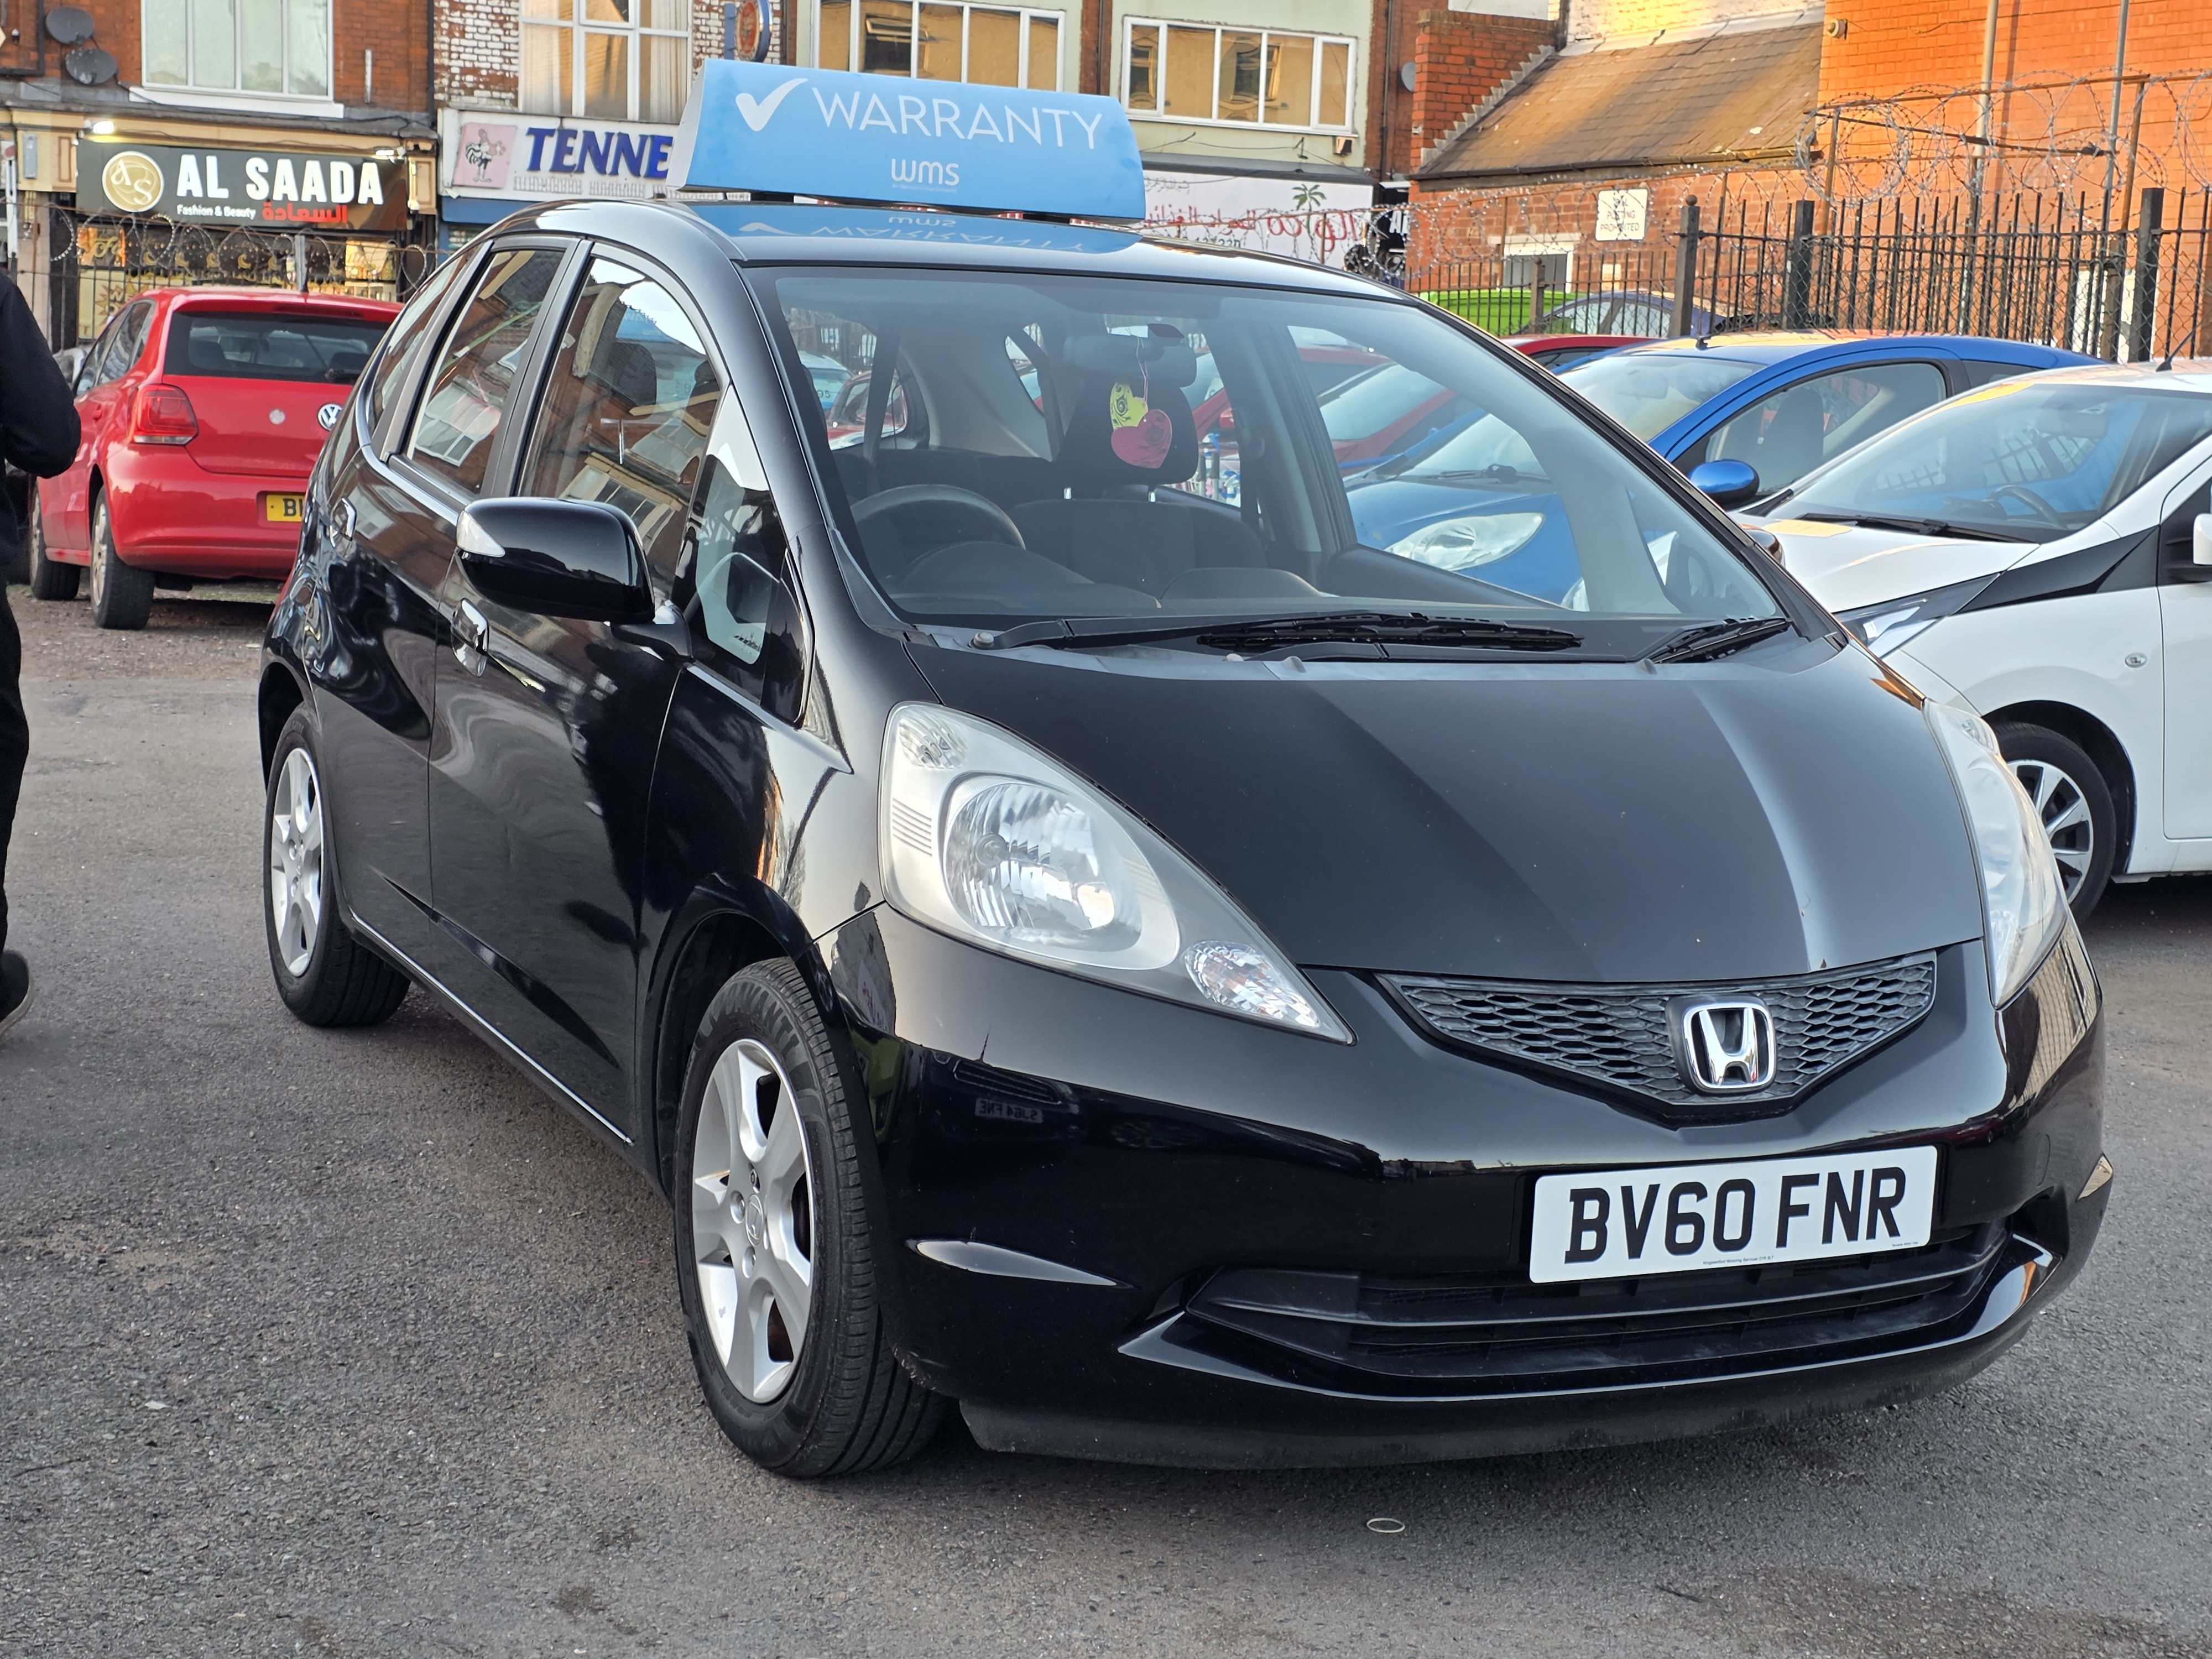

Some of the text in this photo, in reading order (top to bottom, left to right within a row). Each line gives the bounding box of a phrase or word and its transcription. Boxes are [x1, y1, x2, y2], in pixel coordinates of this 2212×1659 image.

[812, 87, 1103, 150] WARRANTY
[525, 127, 674, 179] TENNE
[891, 158, 960, 186] wms
[176, 154, 384, 205] AL SAADA
[177, 204, 257, 220] Fashion & Beauty
[262, 201, 348, 223] السعادة
[1564, 1166, 1906, 1264] BV60 FNR
